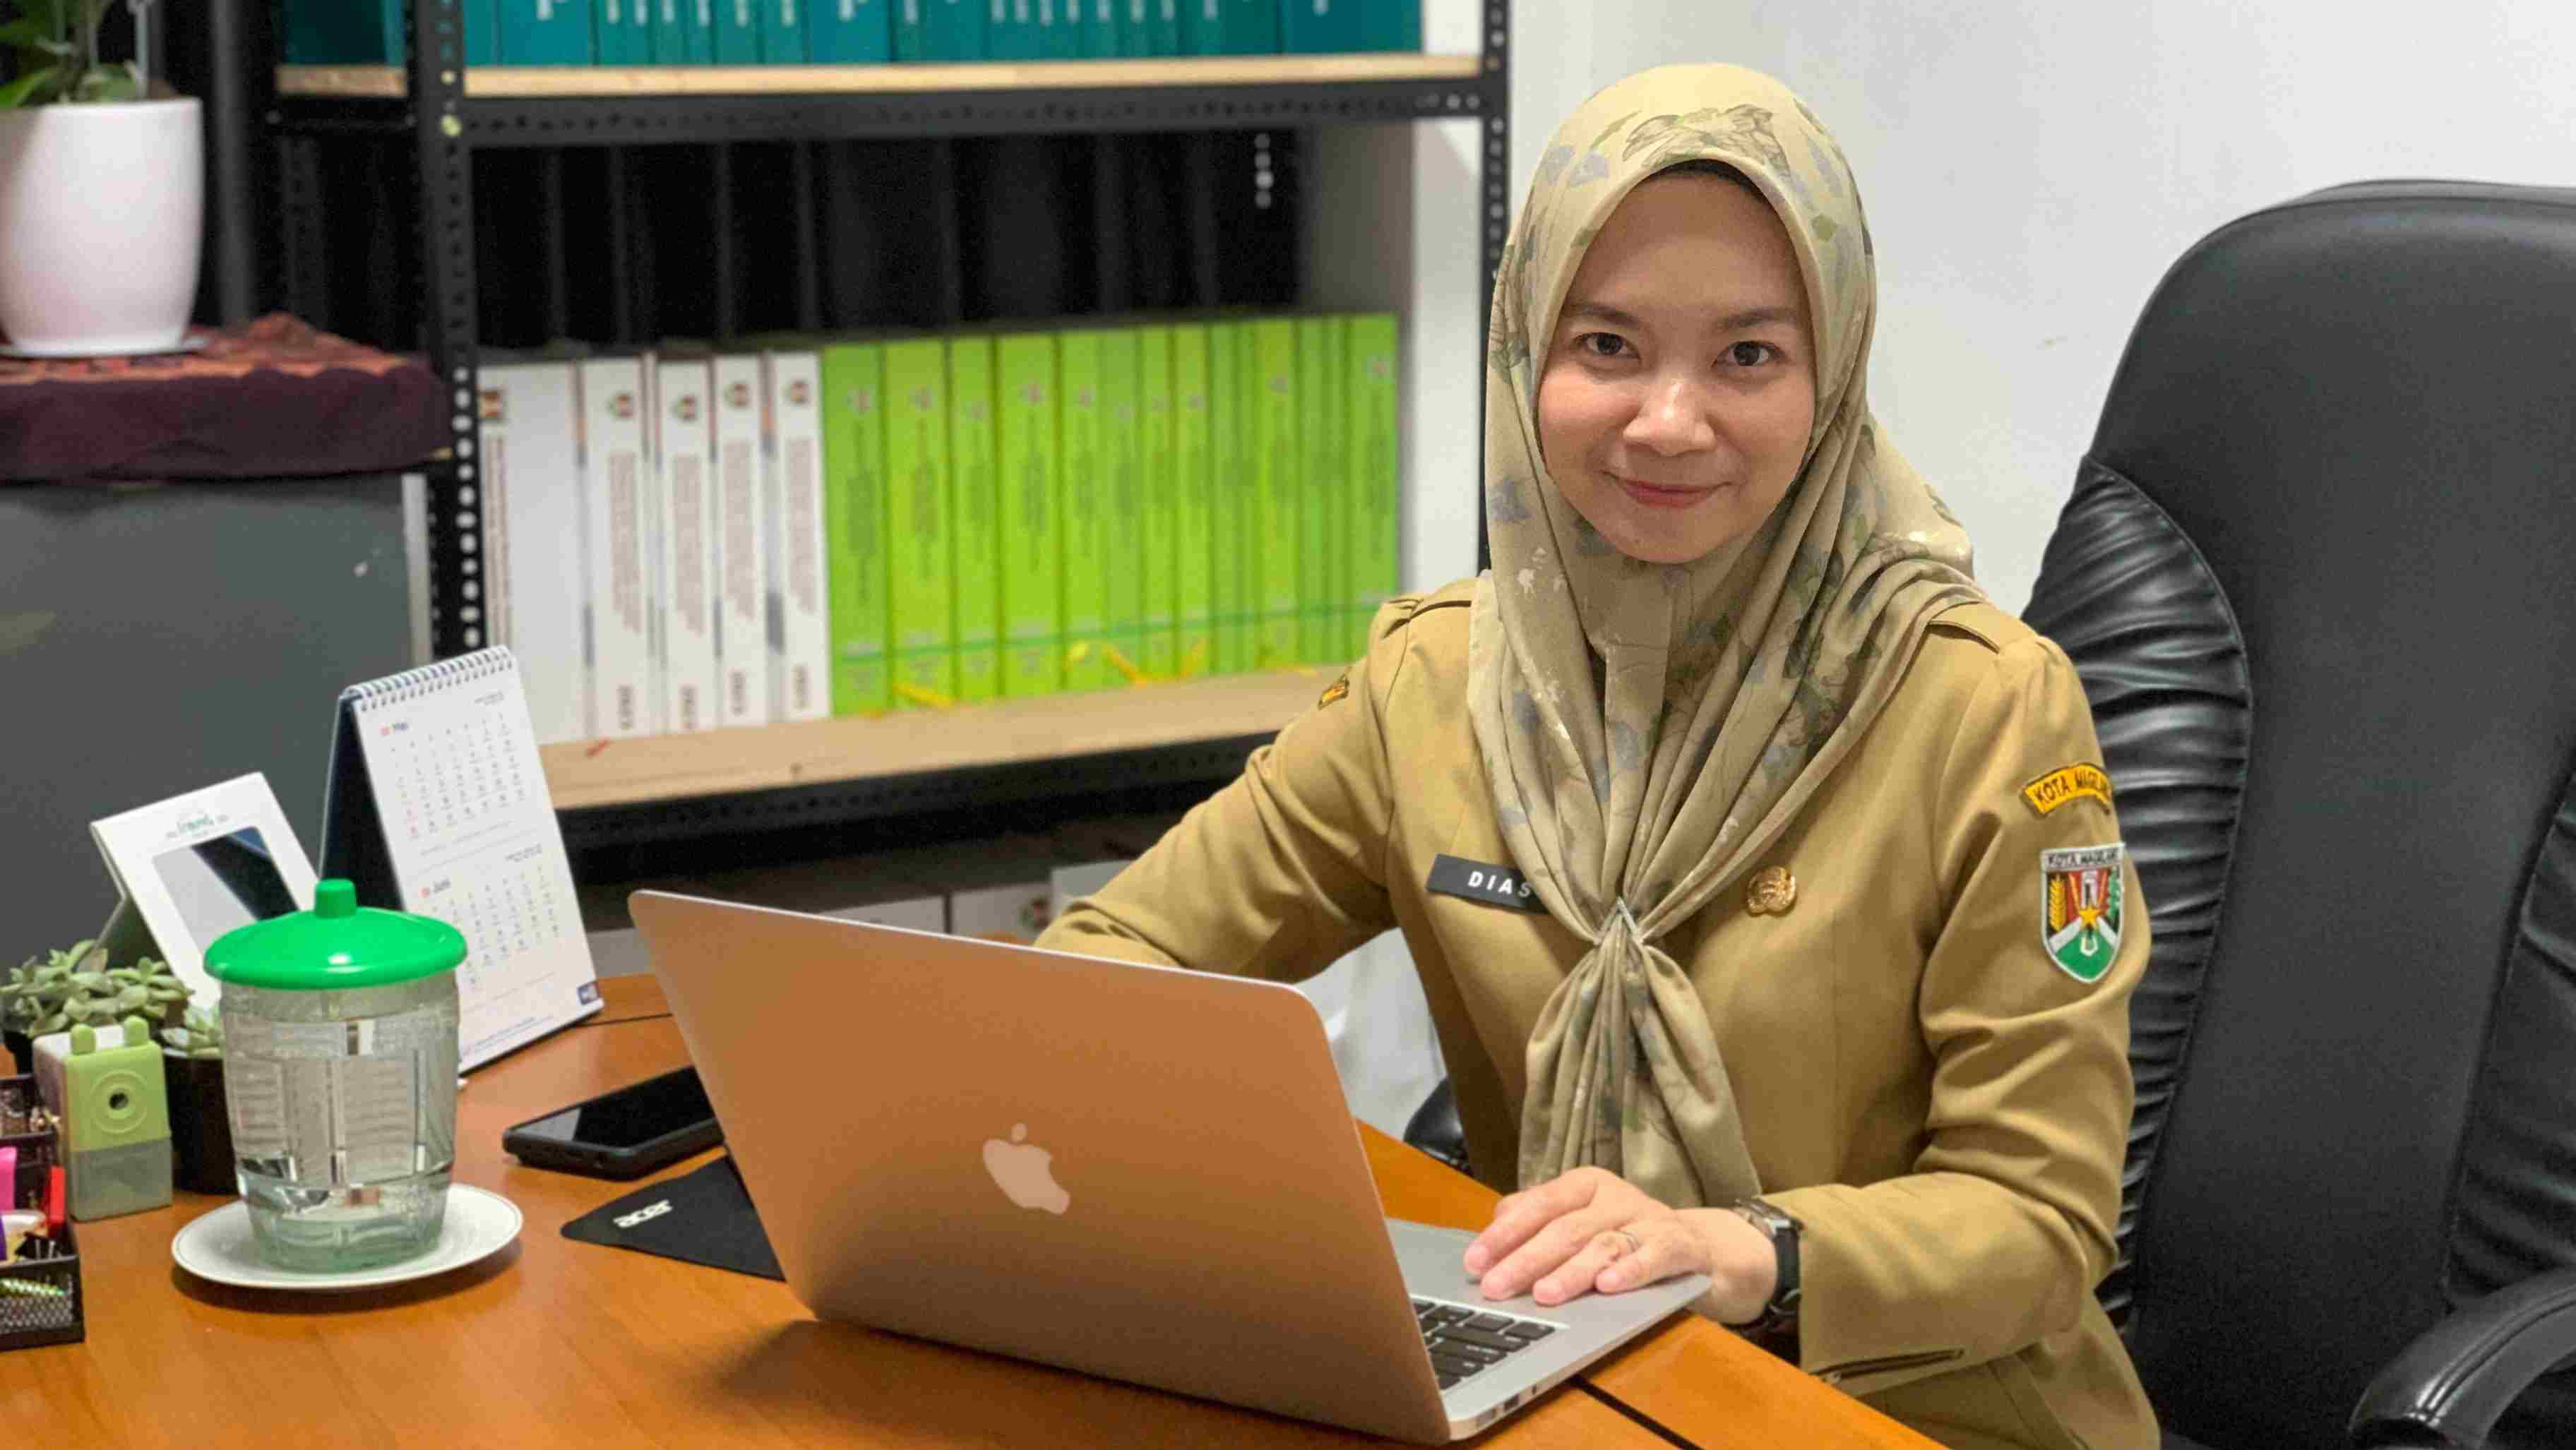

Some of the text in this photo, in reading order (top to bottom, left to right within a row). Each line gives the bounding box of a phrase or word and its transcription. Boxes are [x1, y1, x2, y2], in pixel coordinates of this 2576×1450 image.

[2035, 775, 2072, 802] KOTA
[2048, 853, 2077, 869] KOTA
[1468, 870, 1531, 897] DIAS
[613, 1199, 672, 1228] acer
